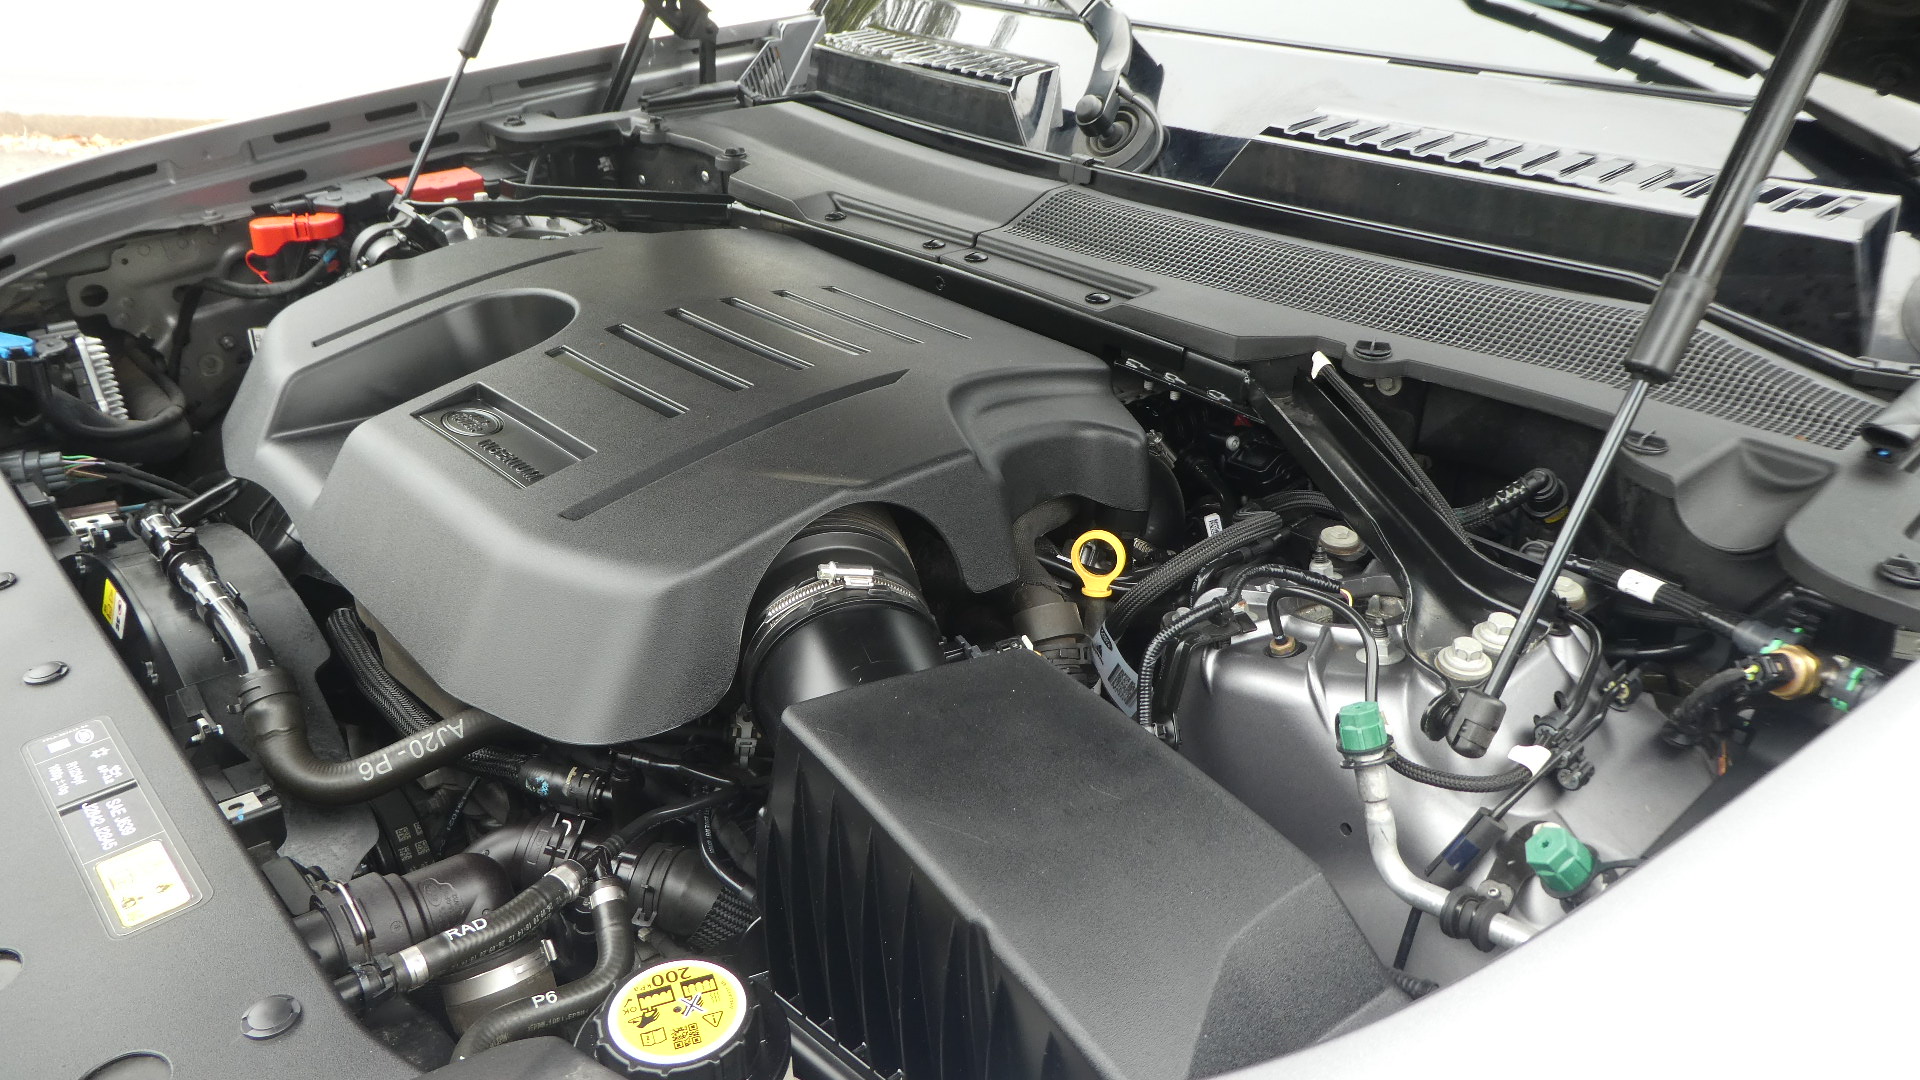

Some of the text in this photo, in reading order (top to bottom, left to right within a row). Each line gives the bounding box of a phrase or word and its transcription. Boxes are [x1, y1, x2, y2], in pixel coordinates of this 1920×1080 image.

[359, 753, 392, 781] P6
[81, 802, 118, 851] J2842 J2845
[105, 798, 136, 836] SAE J639
[445, 917, 488, 941] RAD
[652, 967, 692, 987] 200
[531, 990, 558, 1009] P6
[623, 1006, 638, 1016] OK
